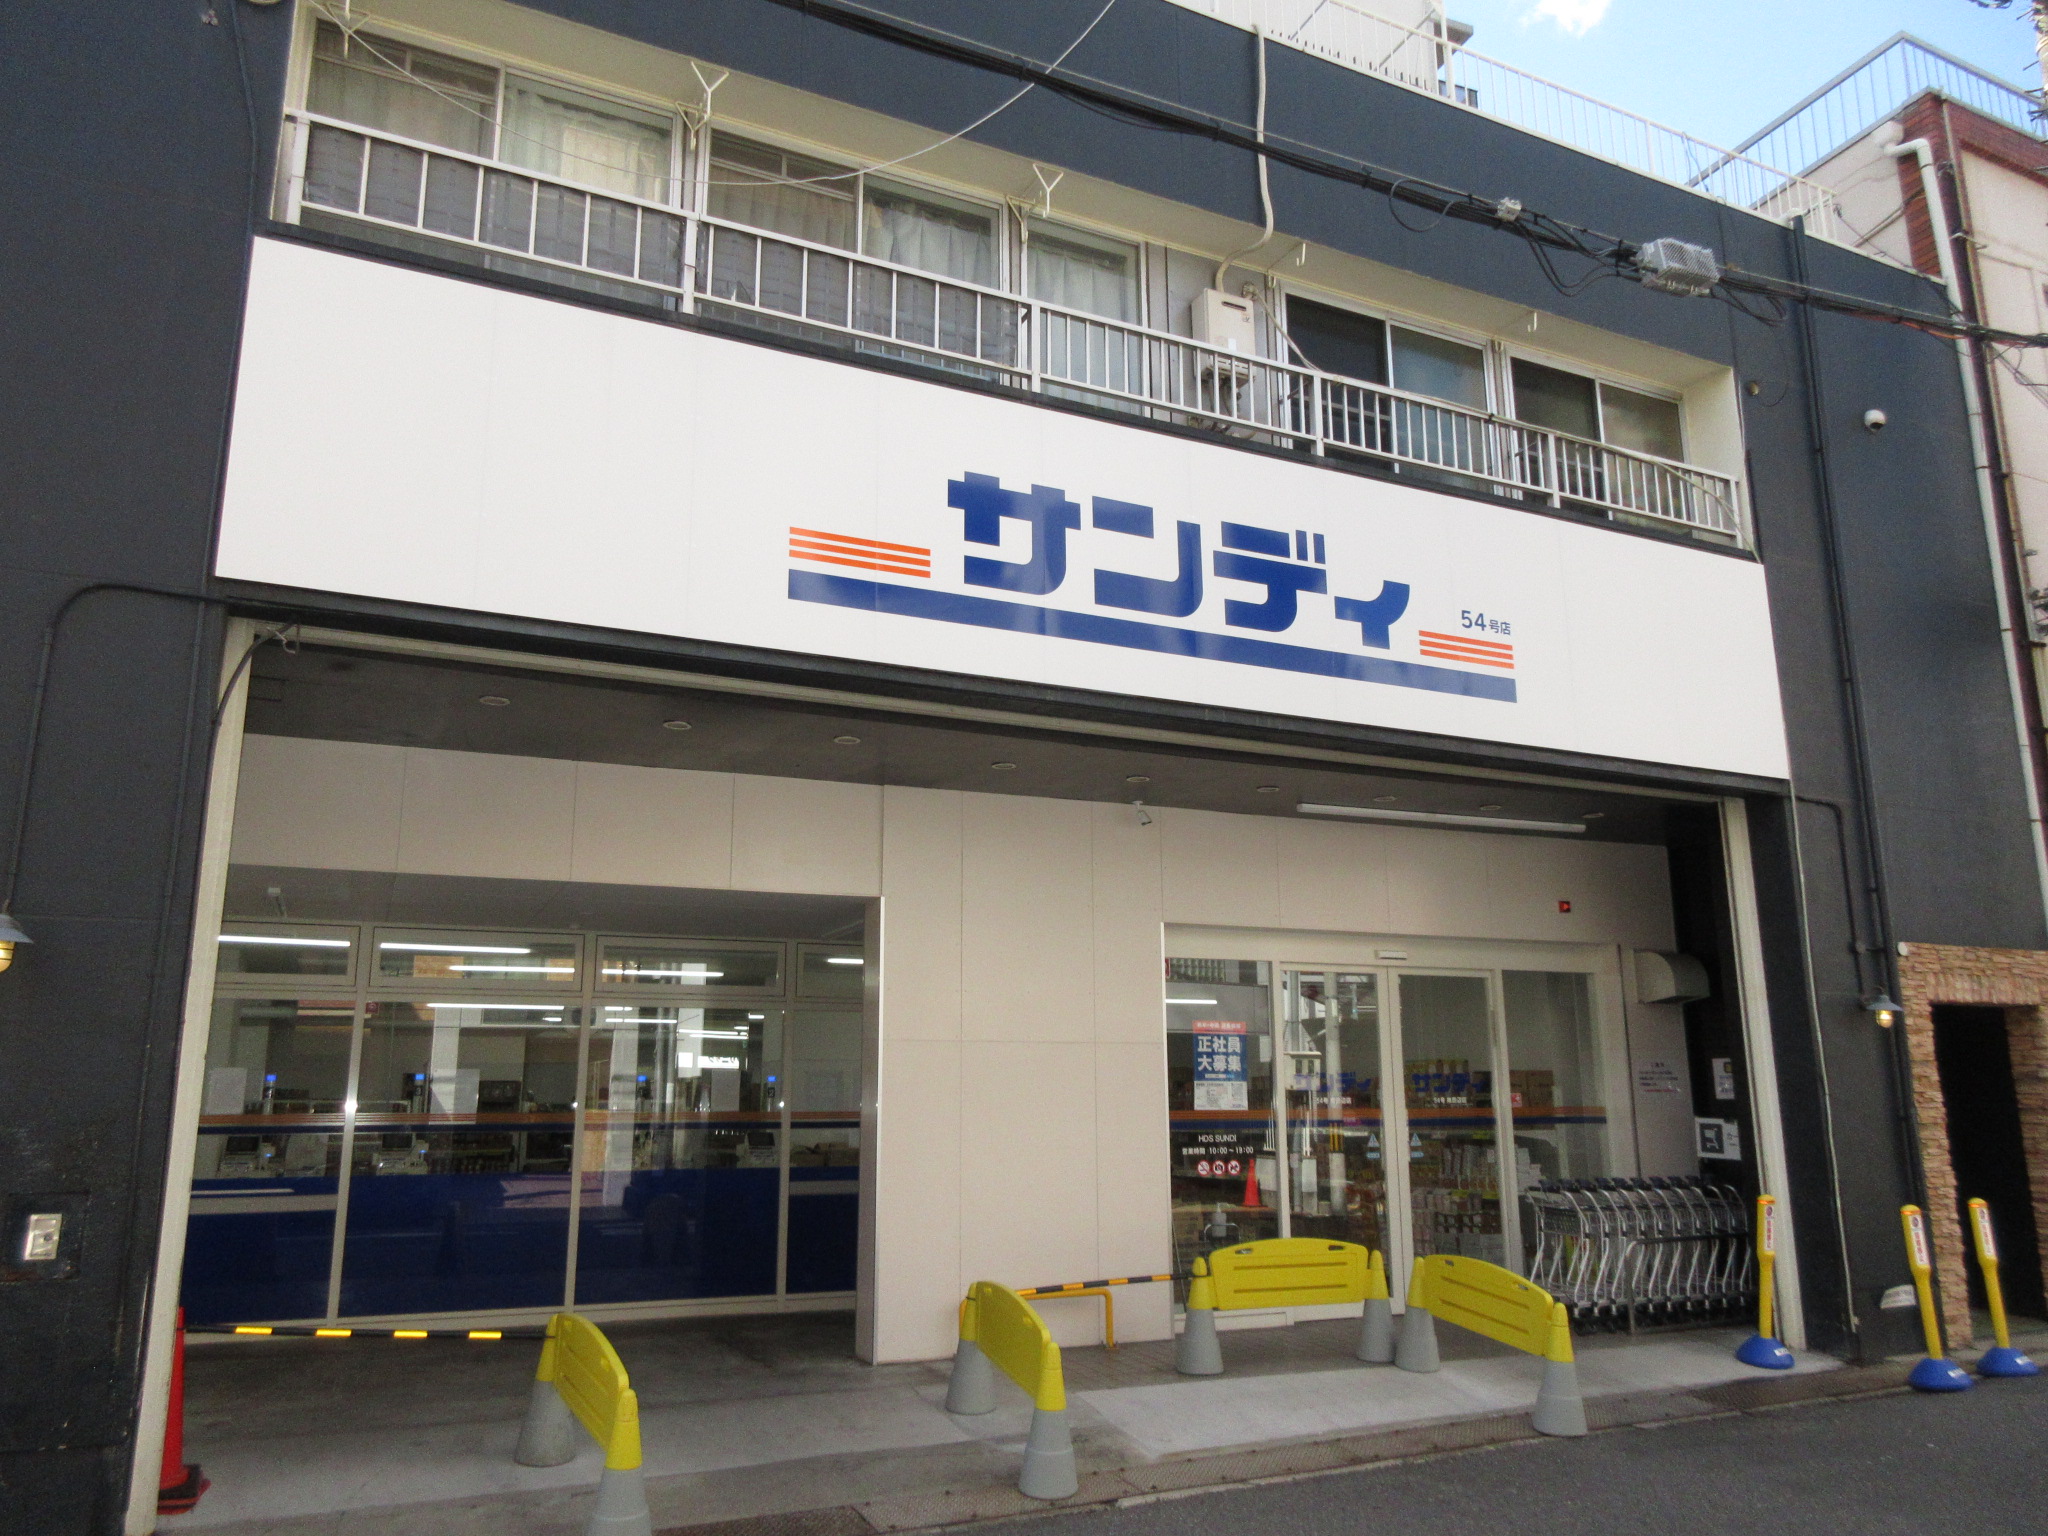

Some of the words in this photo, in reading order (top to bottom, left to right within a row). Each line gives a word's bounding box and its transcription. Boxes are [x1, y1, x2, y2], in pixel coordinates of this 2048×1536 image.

[947, 471, 1410, 650] サンディ
[1461, 609, 1511, 636] 54号店
[1197, 1035, 1242, 1053] 正社員
[1197, 1056, 1242, 1073] 大募集
[1198, 1134, 1214, 1143] HDS
[1215, 1134, 1237, 1142] SUNDI
